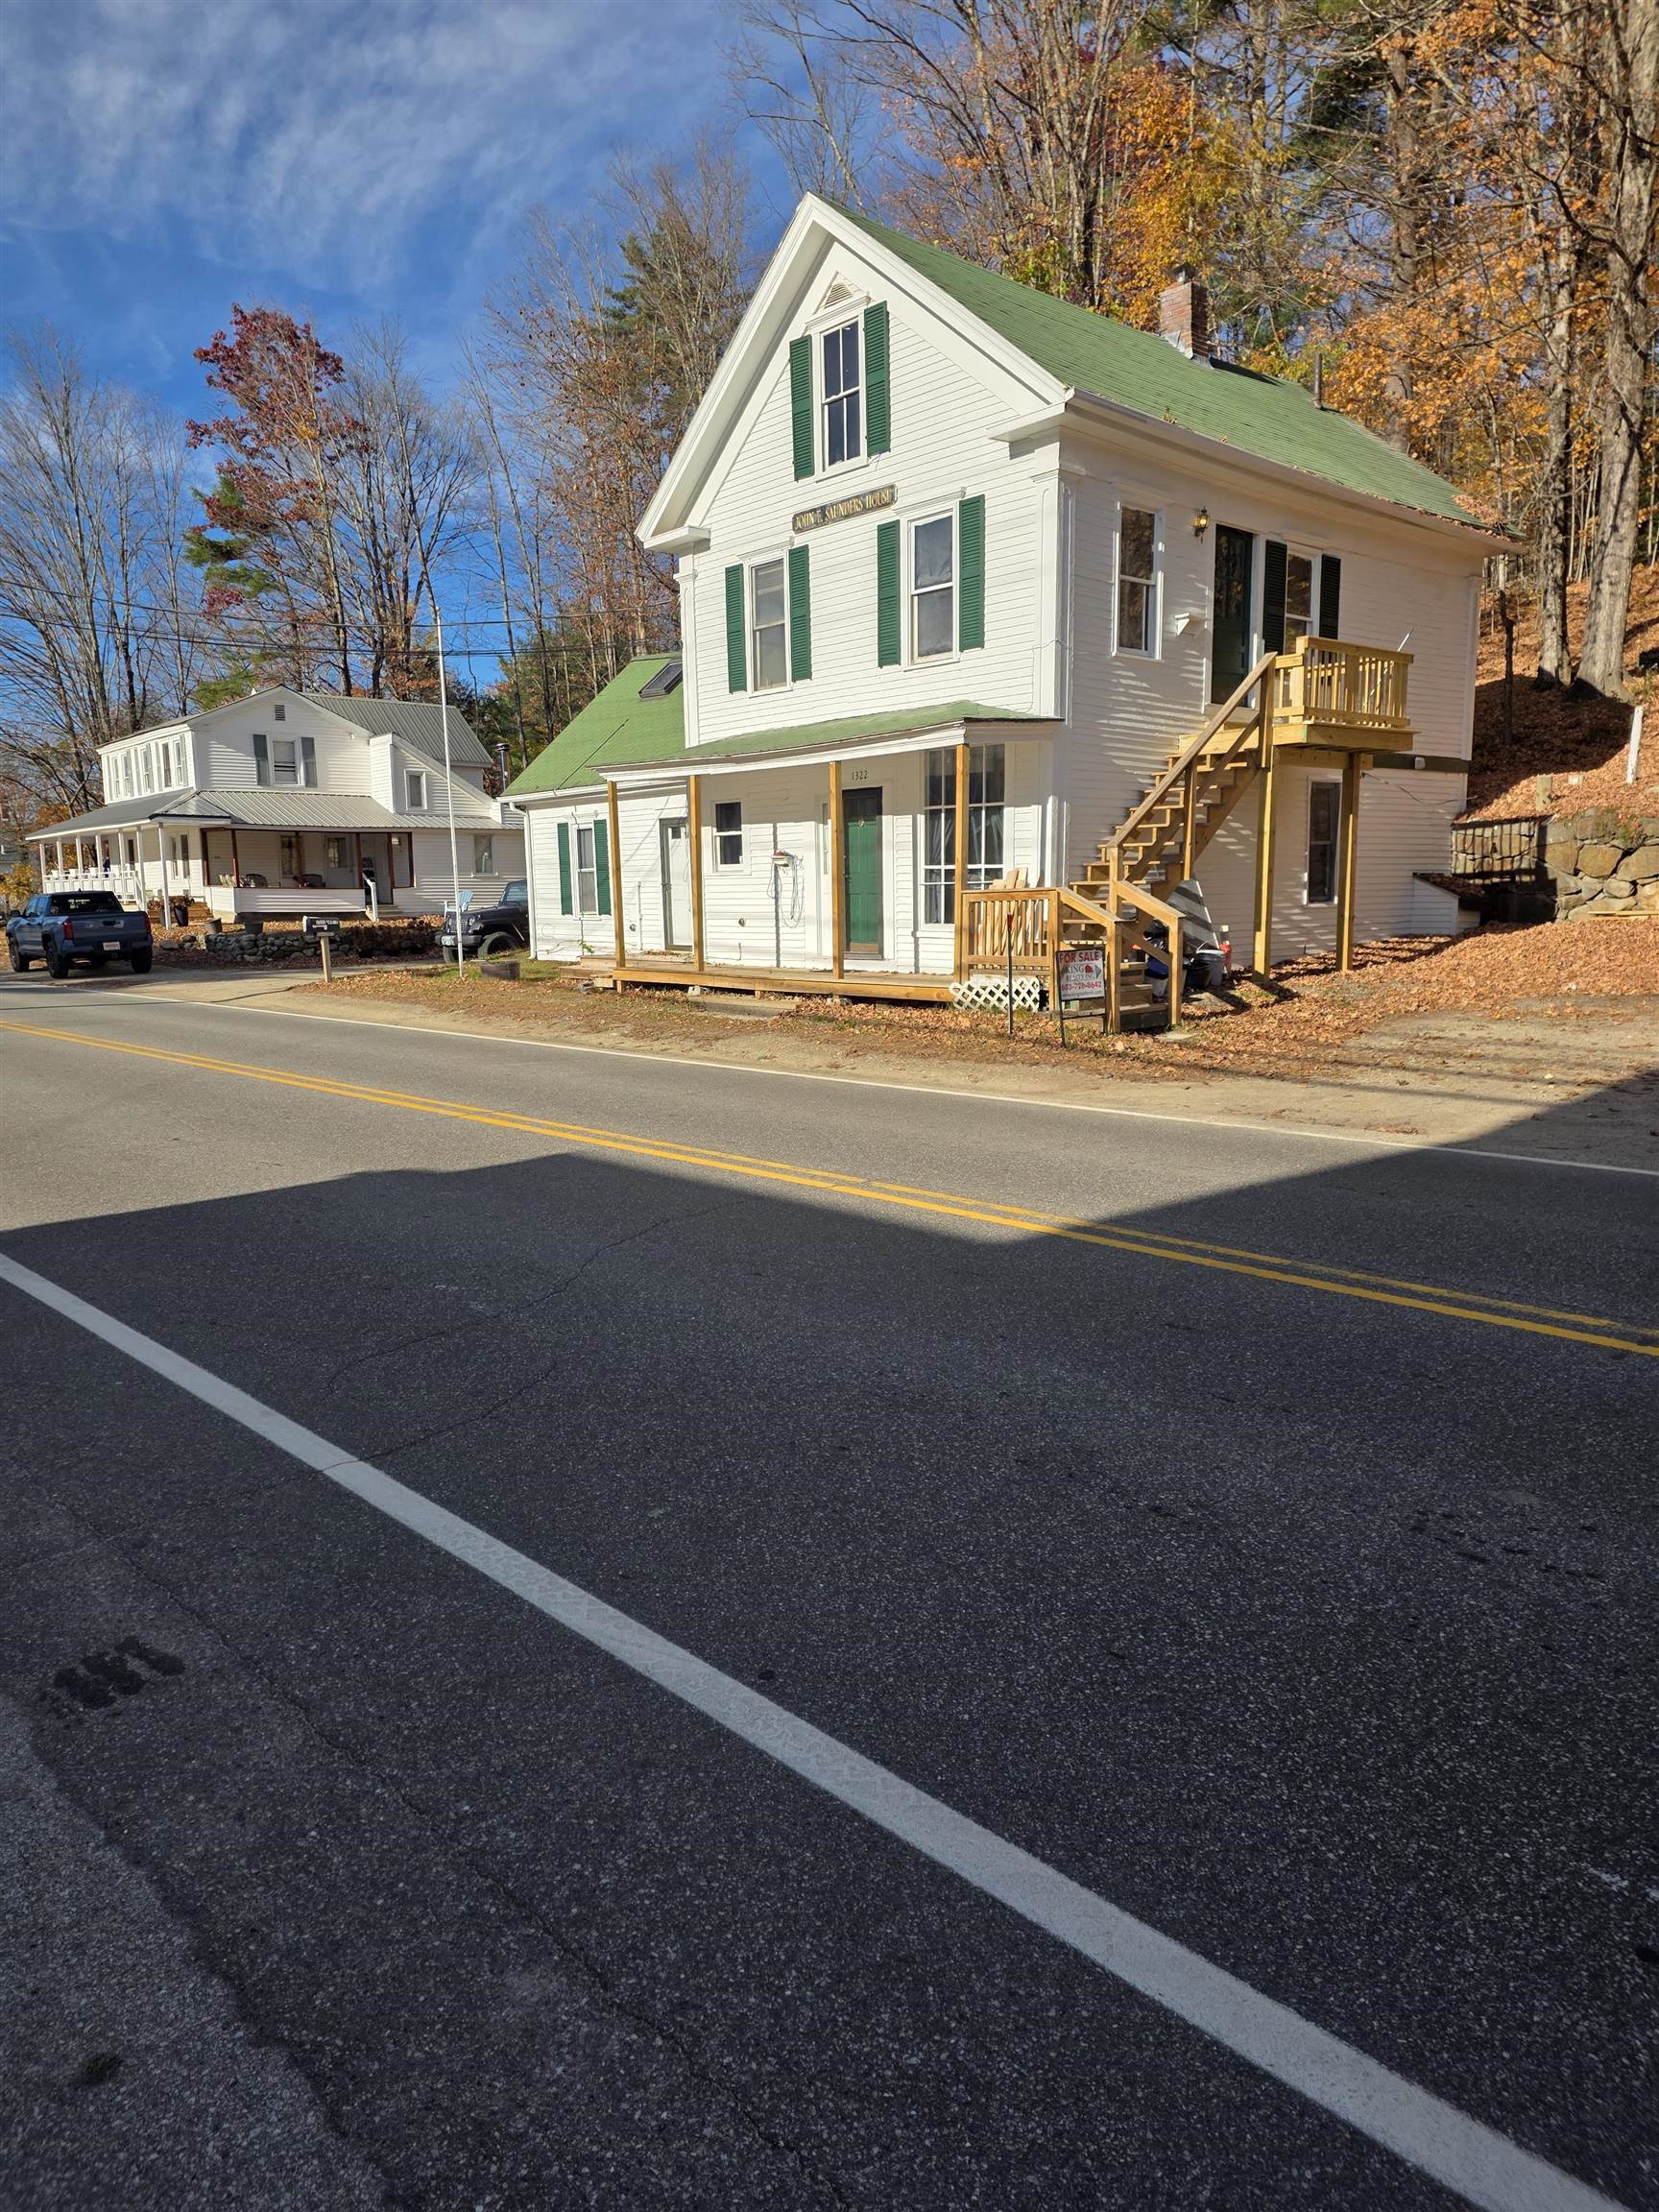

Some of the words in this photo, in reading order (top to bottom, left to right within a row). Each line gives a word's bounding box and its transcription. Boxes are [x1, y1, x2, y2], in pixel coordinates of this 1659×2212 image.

[795, 511, 815, 530] JOHN
[825, 497, 863, 520] SAUNDERS
[865, 488, 892, 509] HOUSE
[852, 770, 868, 781] 1322
[1059, 952, 1076, 963] FOR
[1079, 951, 1099, 962] SALE
[1067, 964, 1084, 974] KING
